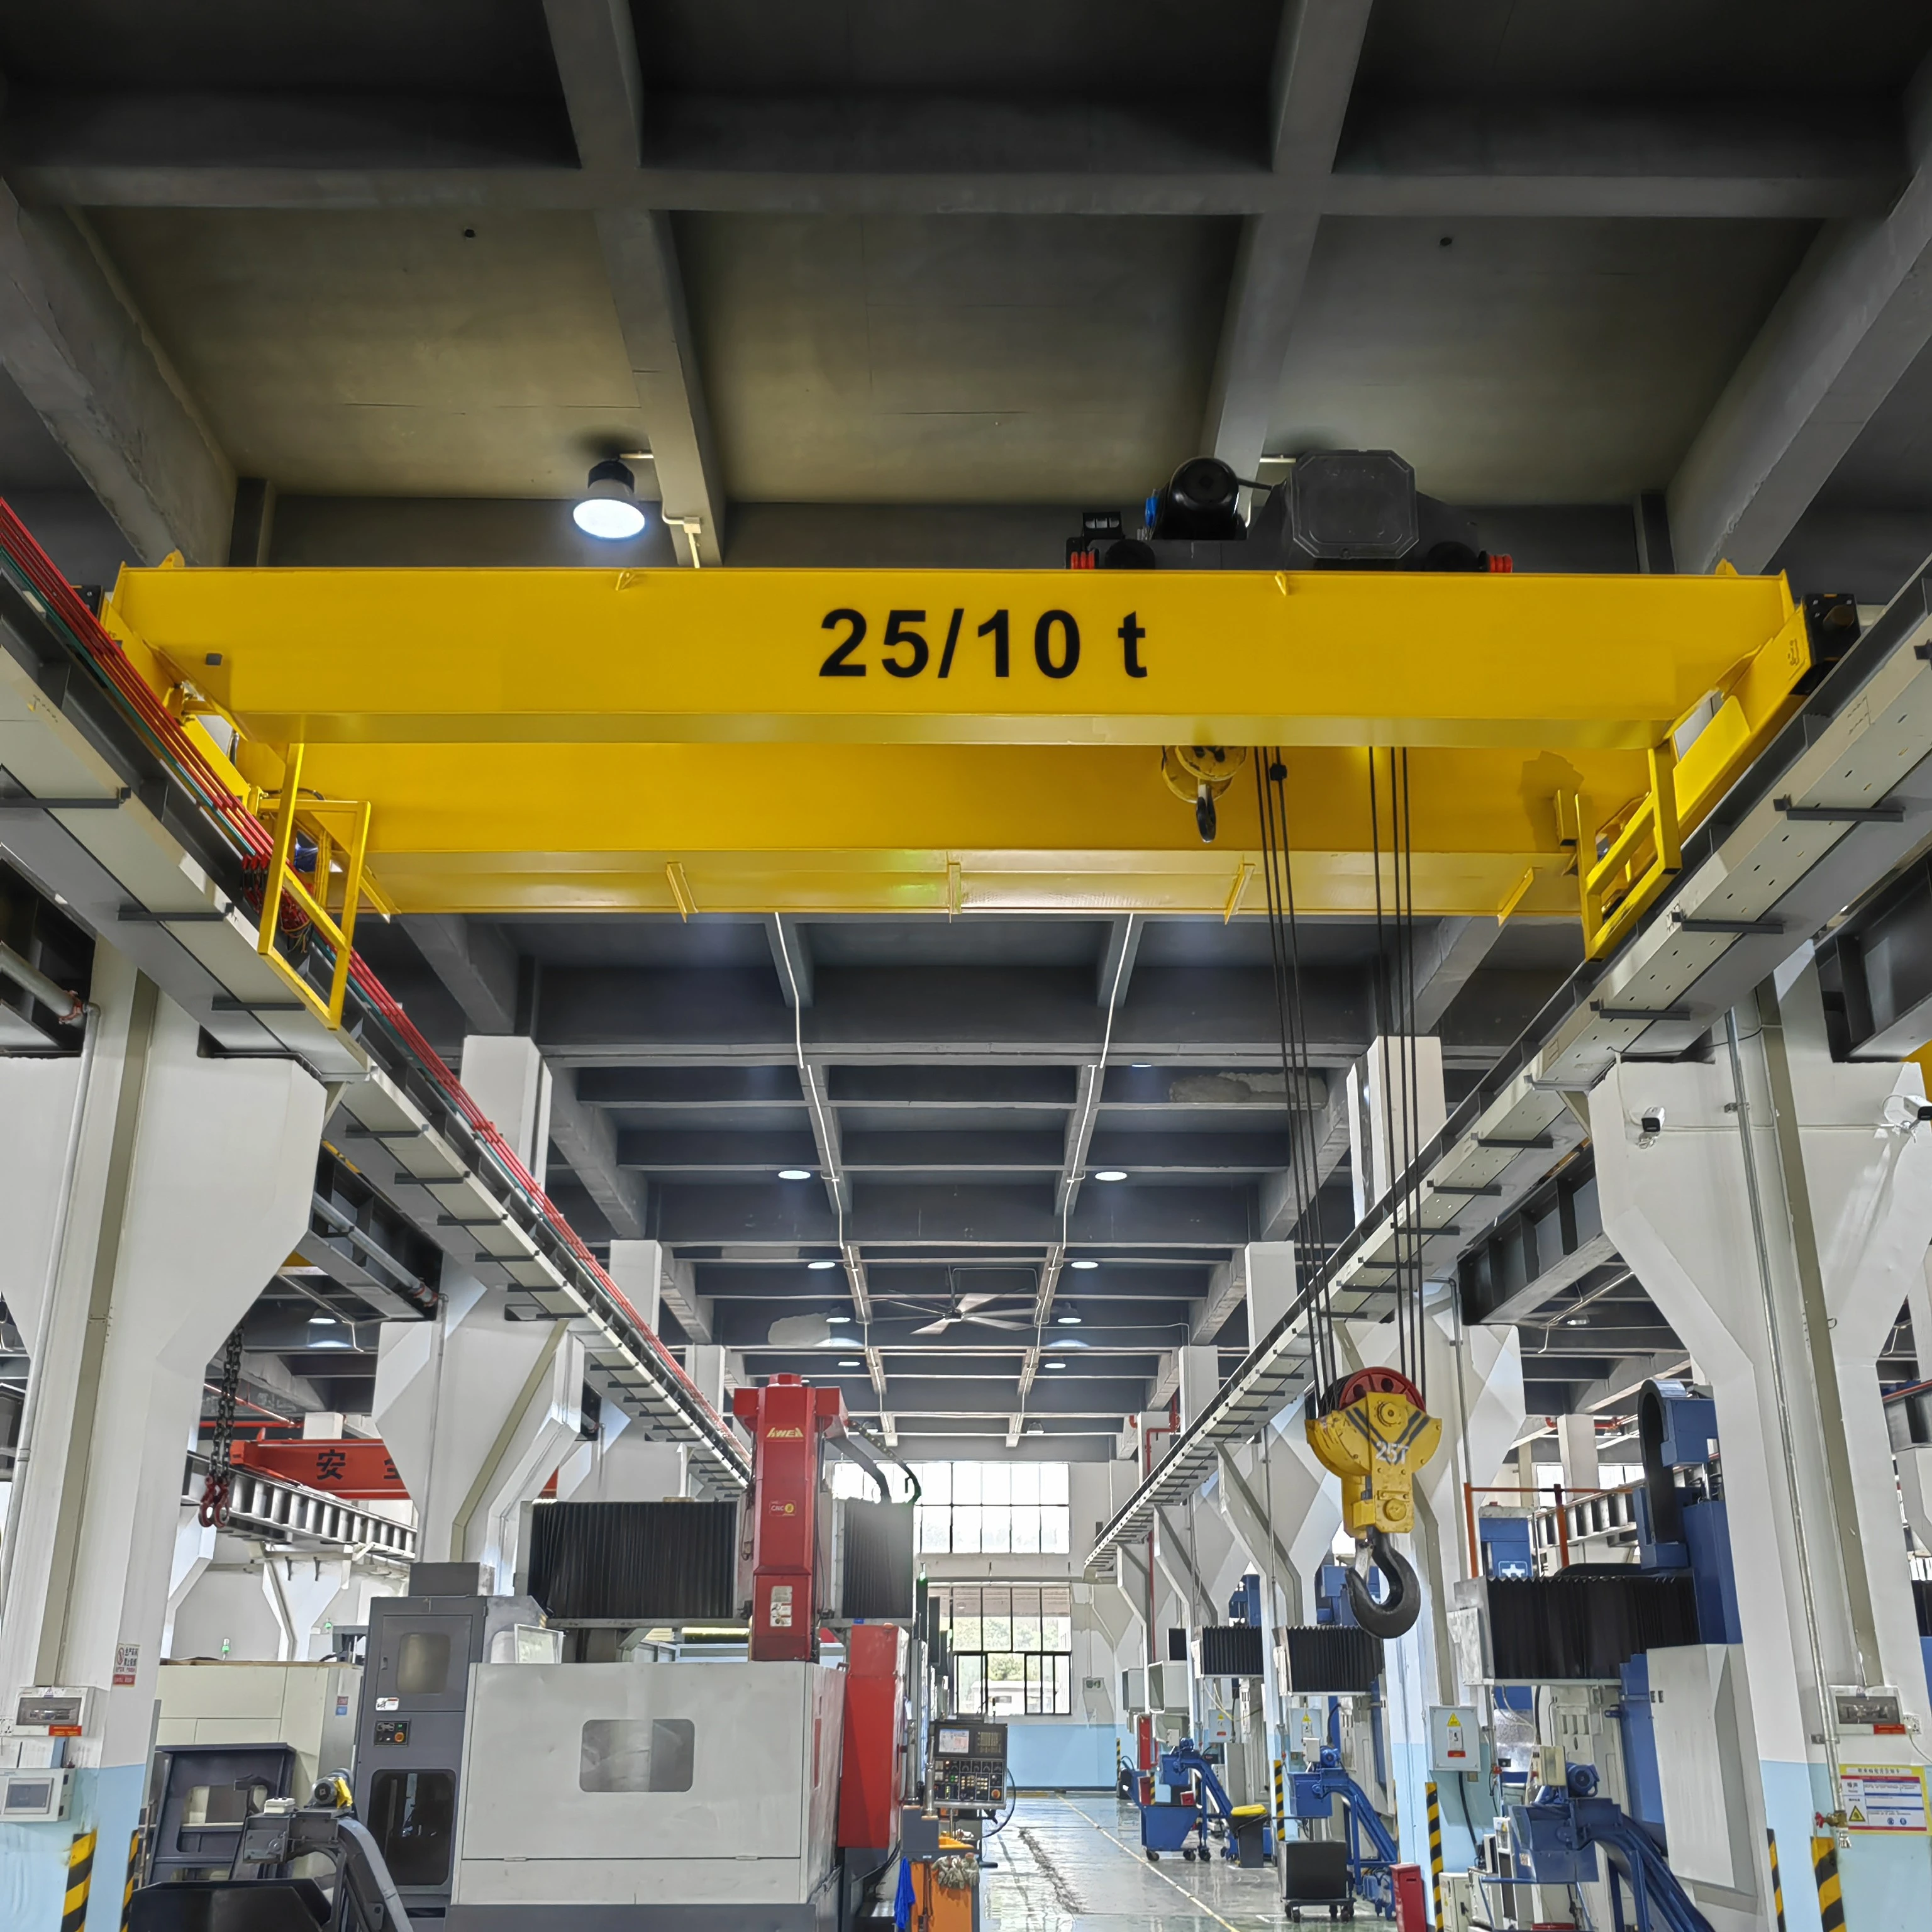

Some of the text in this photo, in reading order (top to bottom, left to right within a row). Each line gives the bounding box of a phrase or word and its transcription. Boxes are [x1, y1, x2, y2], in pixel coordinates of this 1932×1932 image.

[818, 608, 1147, 679] 25/10 t
[1375, 1440, 1409, 1465] 25T
